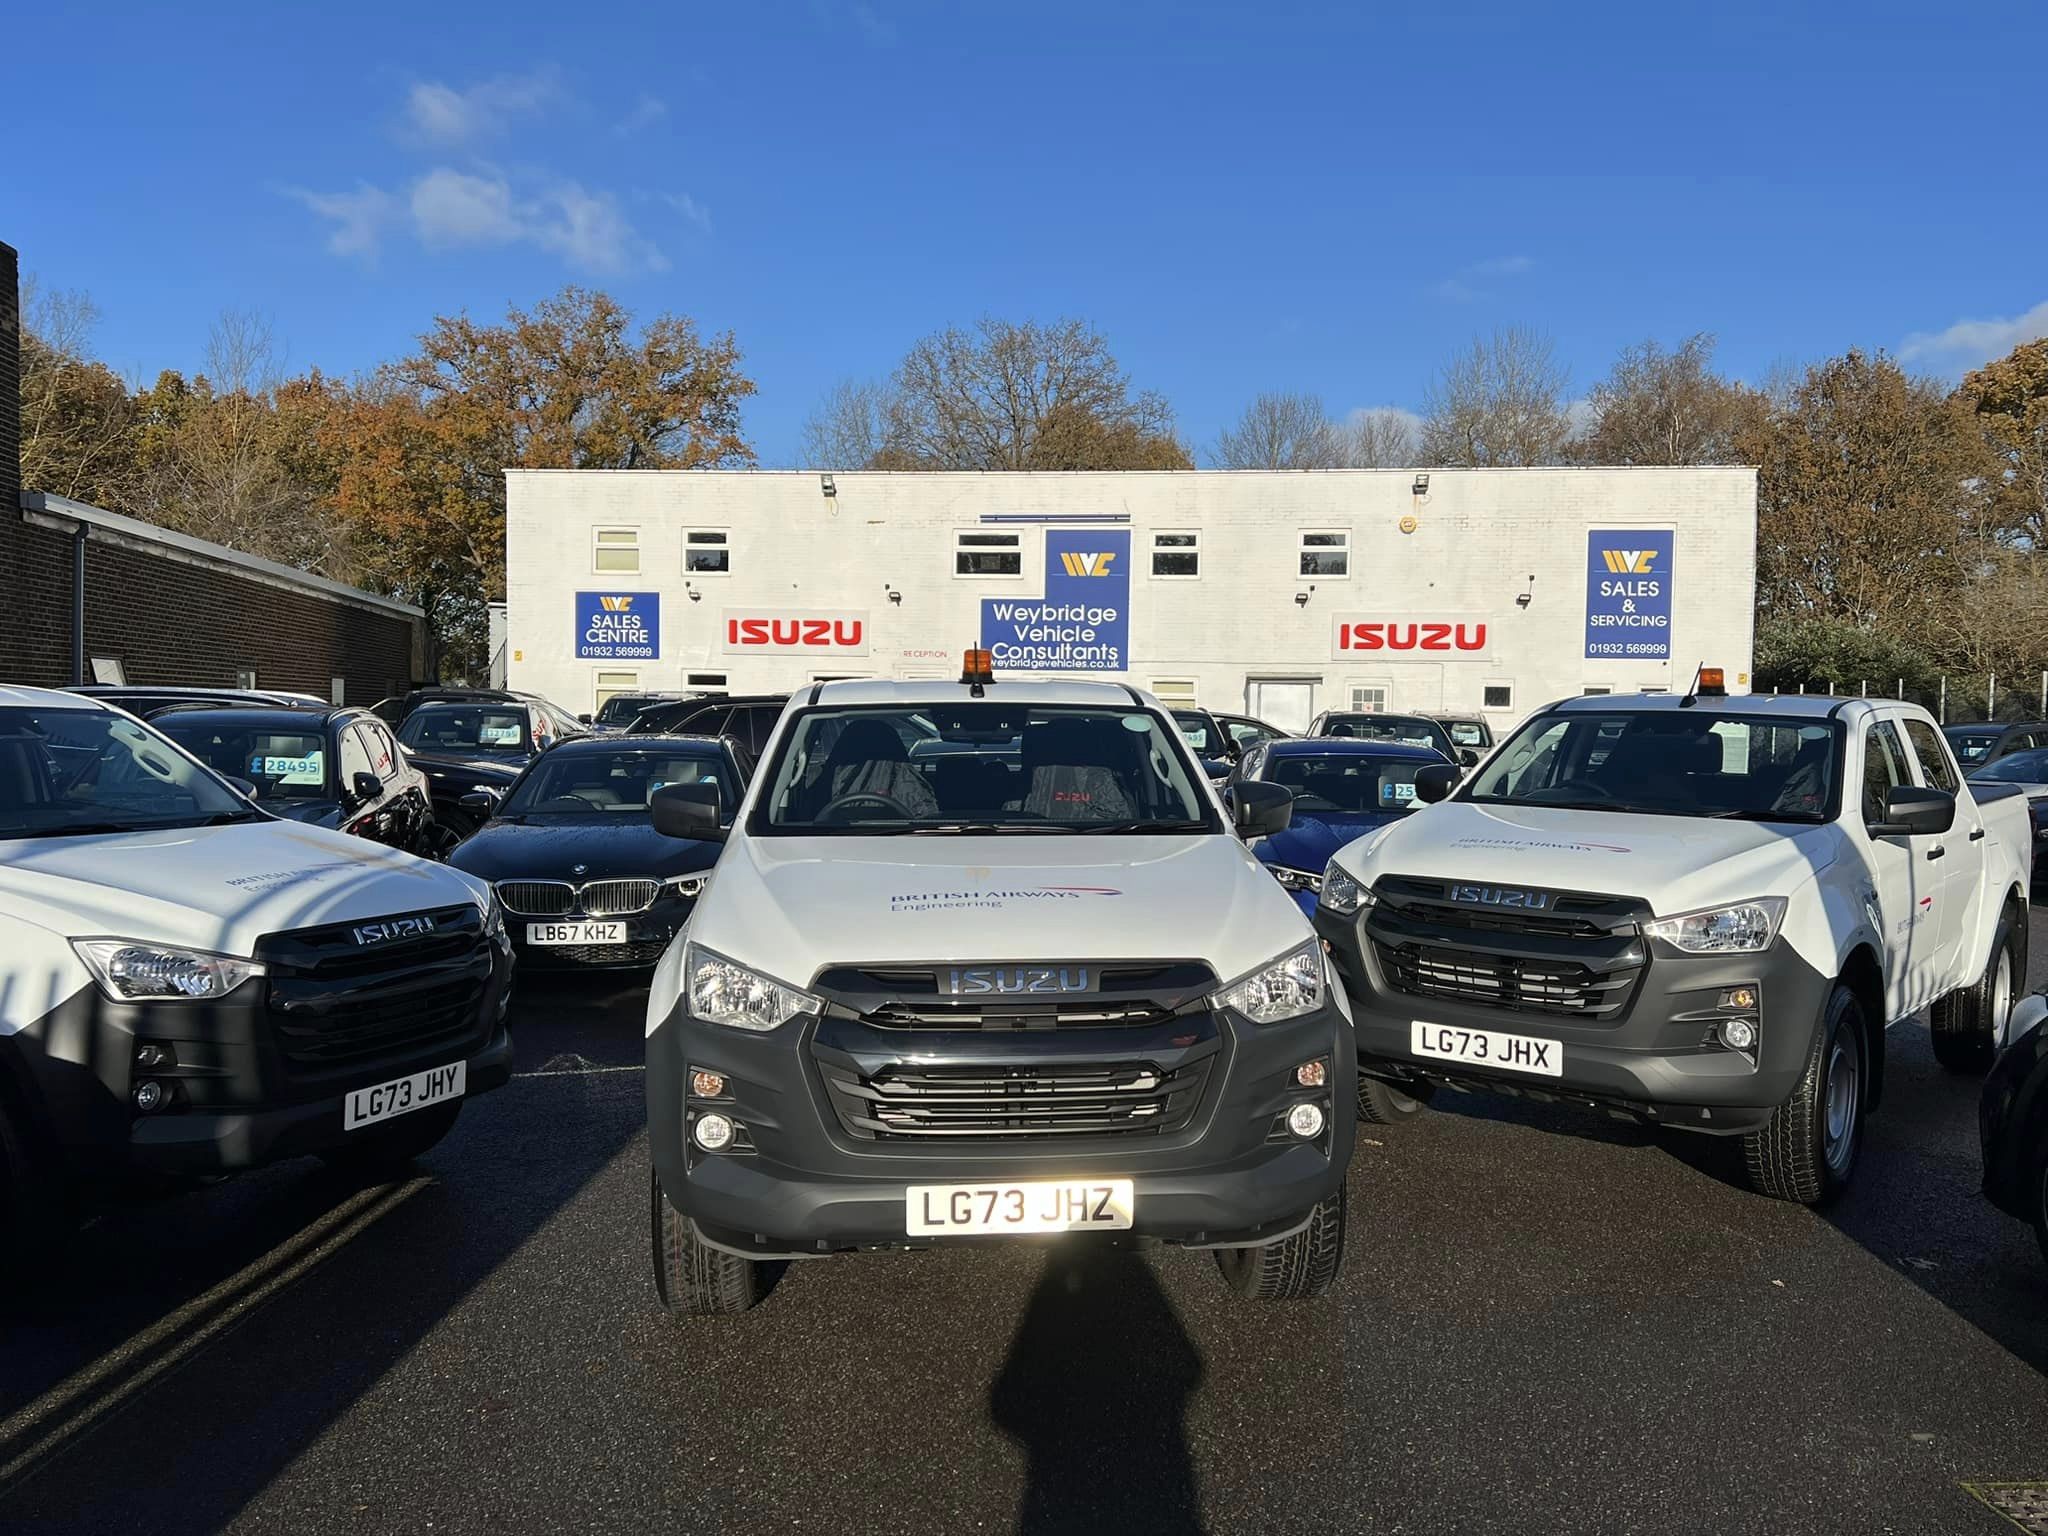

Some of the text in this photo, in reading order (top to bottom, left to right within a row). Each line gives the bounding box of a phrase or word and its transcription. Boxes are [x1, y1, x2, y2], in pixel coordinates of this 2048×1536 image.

[1600, 581, 1660, 596] SALES
[1622, 599, 1636, 613] &
[591, 614, 641, 628] SALES
[992, 603, 1117, 626] Weybridge
[1590, 615, 1667, 627] SERVICING
[585, 628, 649, 643] CENTRE
[728, 619, 862, 646] ISUZU
[1014, 625, 1096, 642] Vehicle
[1340, 623, 1486, 650] ISUZU
[581, 646, 652, 657] 01932 569999
[903, 650, 948, 658] RECEPTION
[991, 642, 1118, 660] Consultants
[1589, 643, 1667, 654] 01932 569999
[1383, 783, 1415, 799] £25
[891, 891, 1080, 902] BRITISH AIRWAYS
[1450, 884, 1548, 909] ISUZU
[891, 900, 1003, 912] Engineering
[353, 916, 435, 945] ISUZU
[534, 925, 617, 941] LB67 KHZ
[950, 967, 1089, 994] ISUZU
[1422, 1026, 1549, 1068] LG73 JHX
[354, 1066, 457, 1122] LG73 JHY
[923, 1187, 1114, 1226] LG73 JHZ
